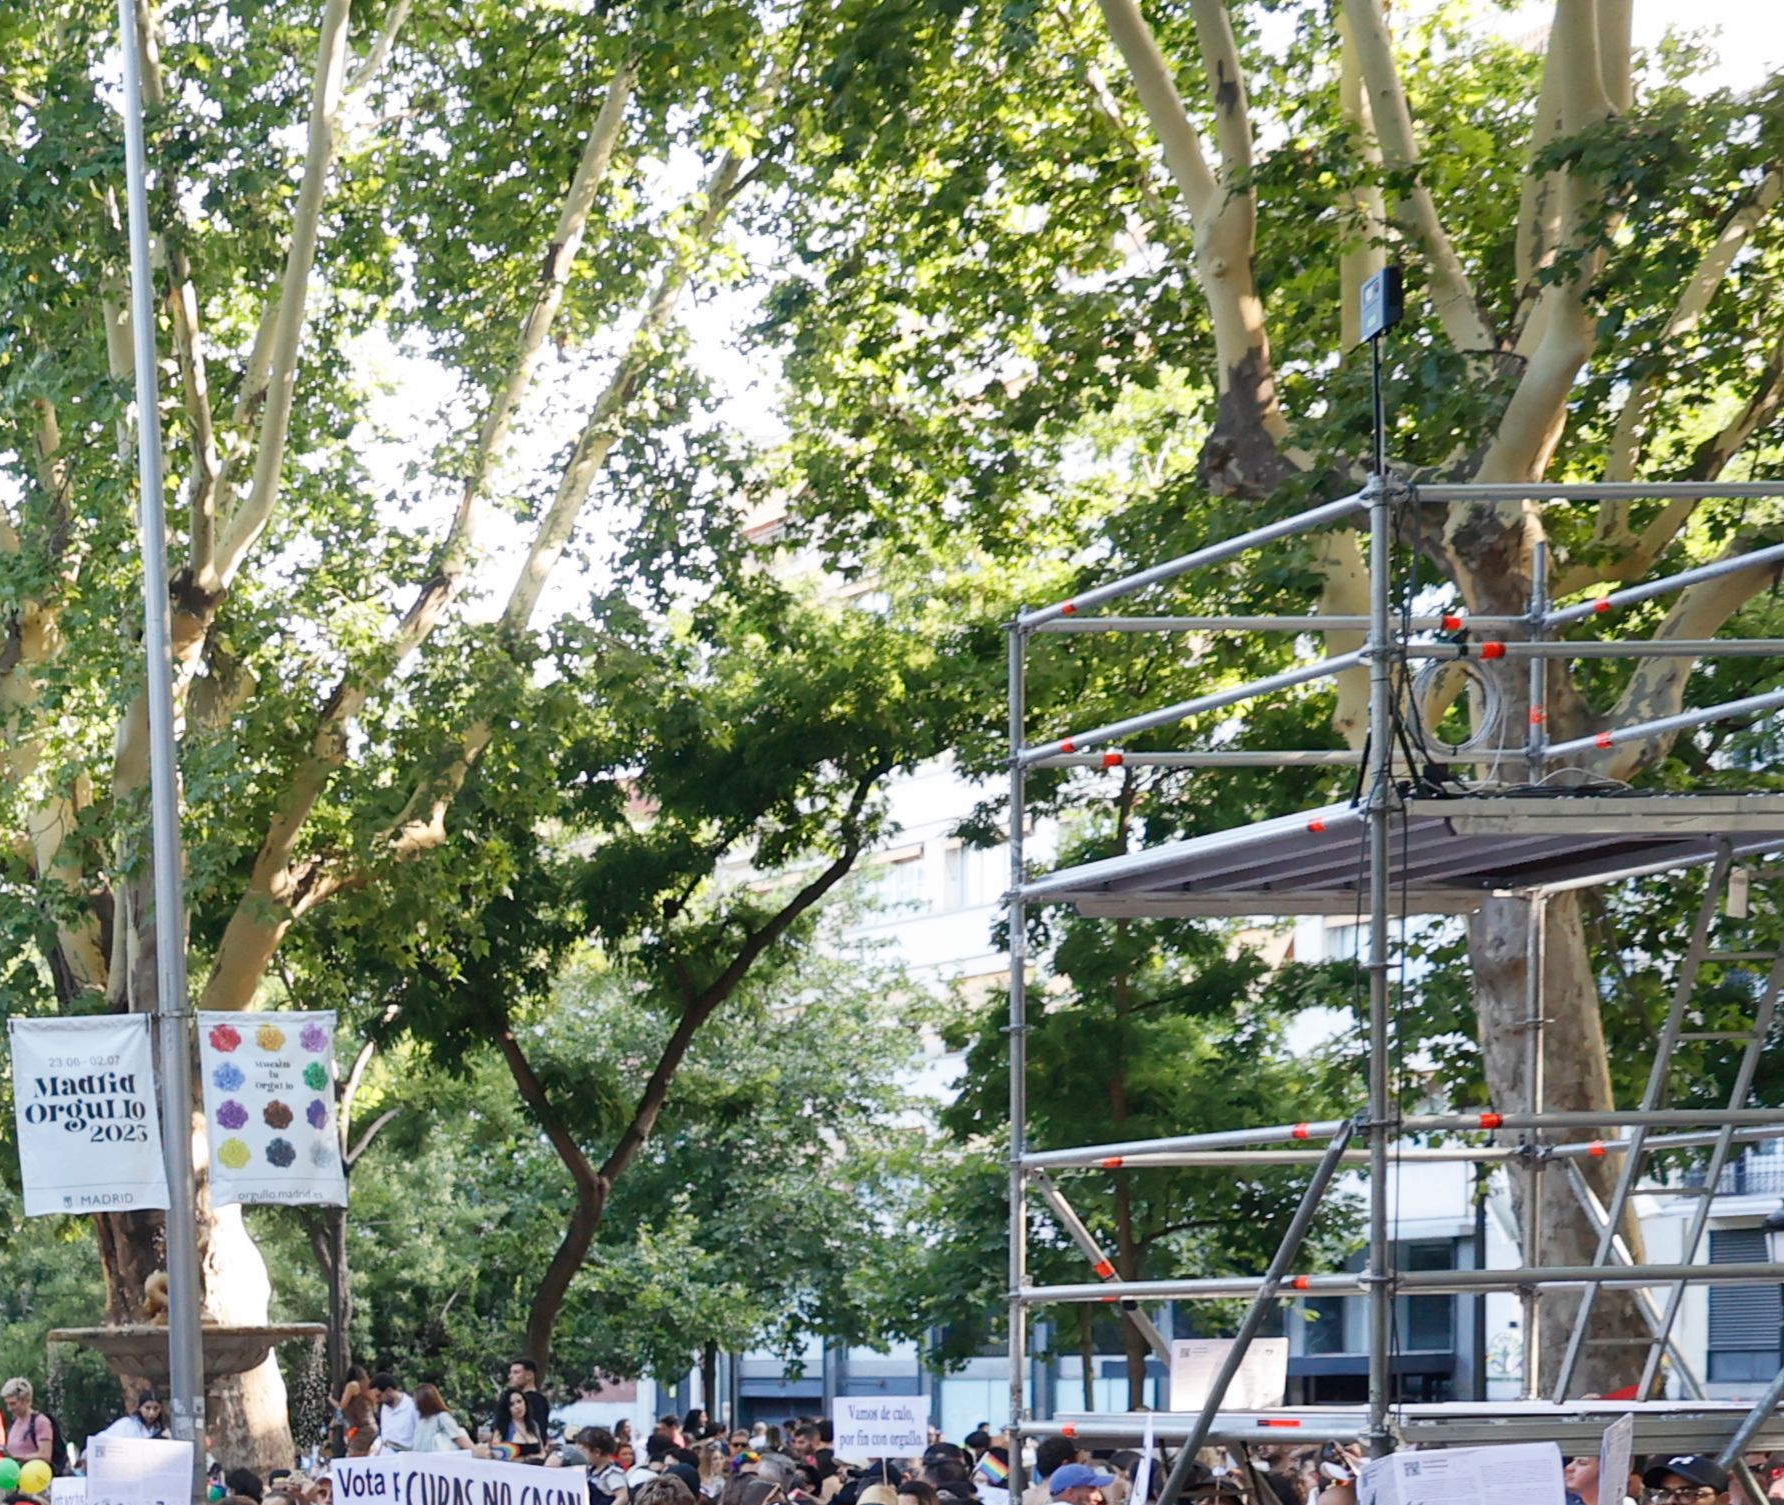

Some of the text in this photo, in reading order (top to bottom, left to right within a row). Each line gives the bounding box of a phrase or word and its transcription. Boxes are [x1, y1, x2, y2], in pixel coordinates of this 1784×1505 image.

[89, 1055, 121, 1067] 02.07
[34, 1072, 137, 1099] Madrid
[90, 1124, 149, 1143] 2023
[81, 1193, 134, 1206] MADRID
[848, 1404, 879, 1420] Vamos
[880, 1405, 891, 1420] de
[839, 1435, 854, 1450] por
[856, 1430, 869, 1446] fin
[873, 1435, 888, 1446] con
[337, 1467, 386, 1498] Vota
